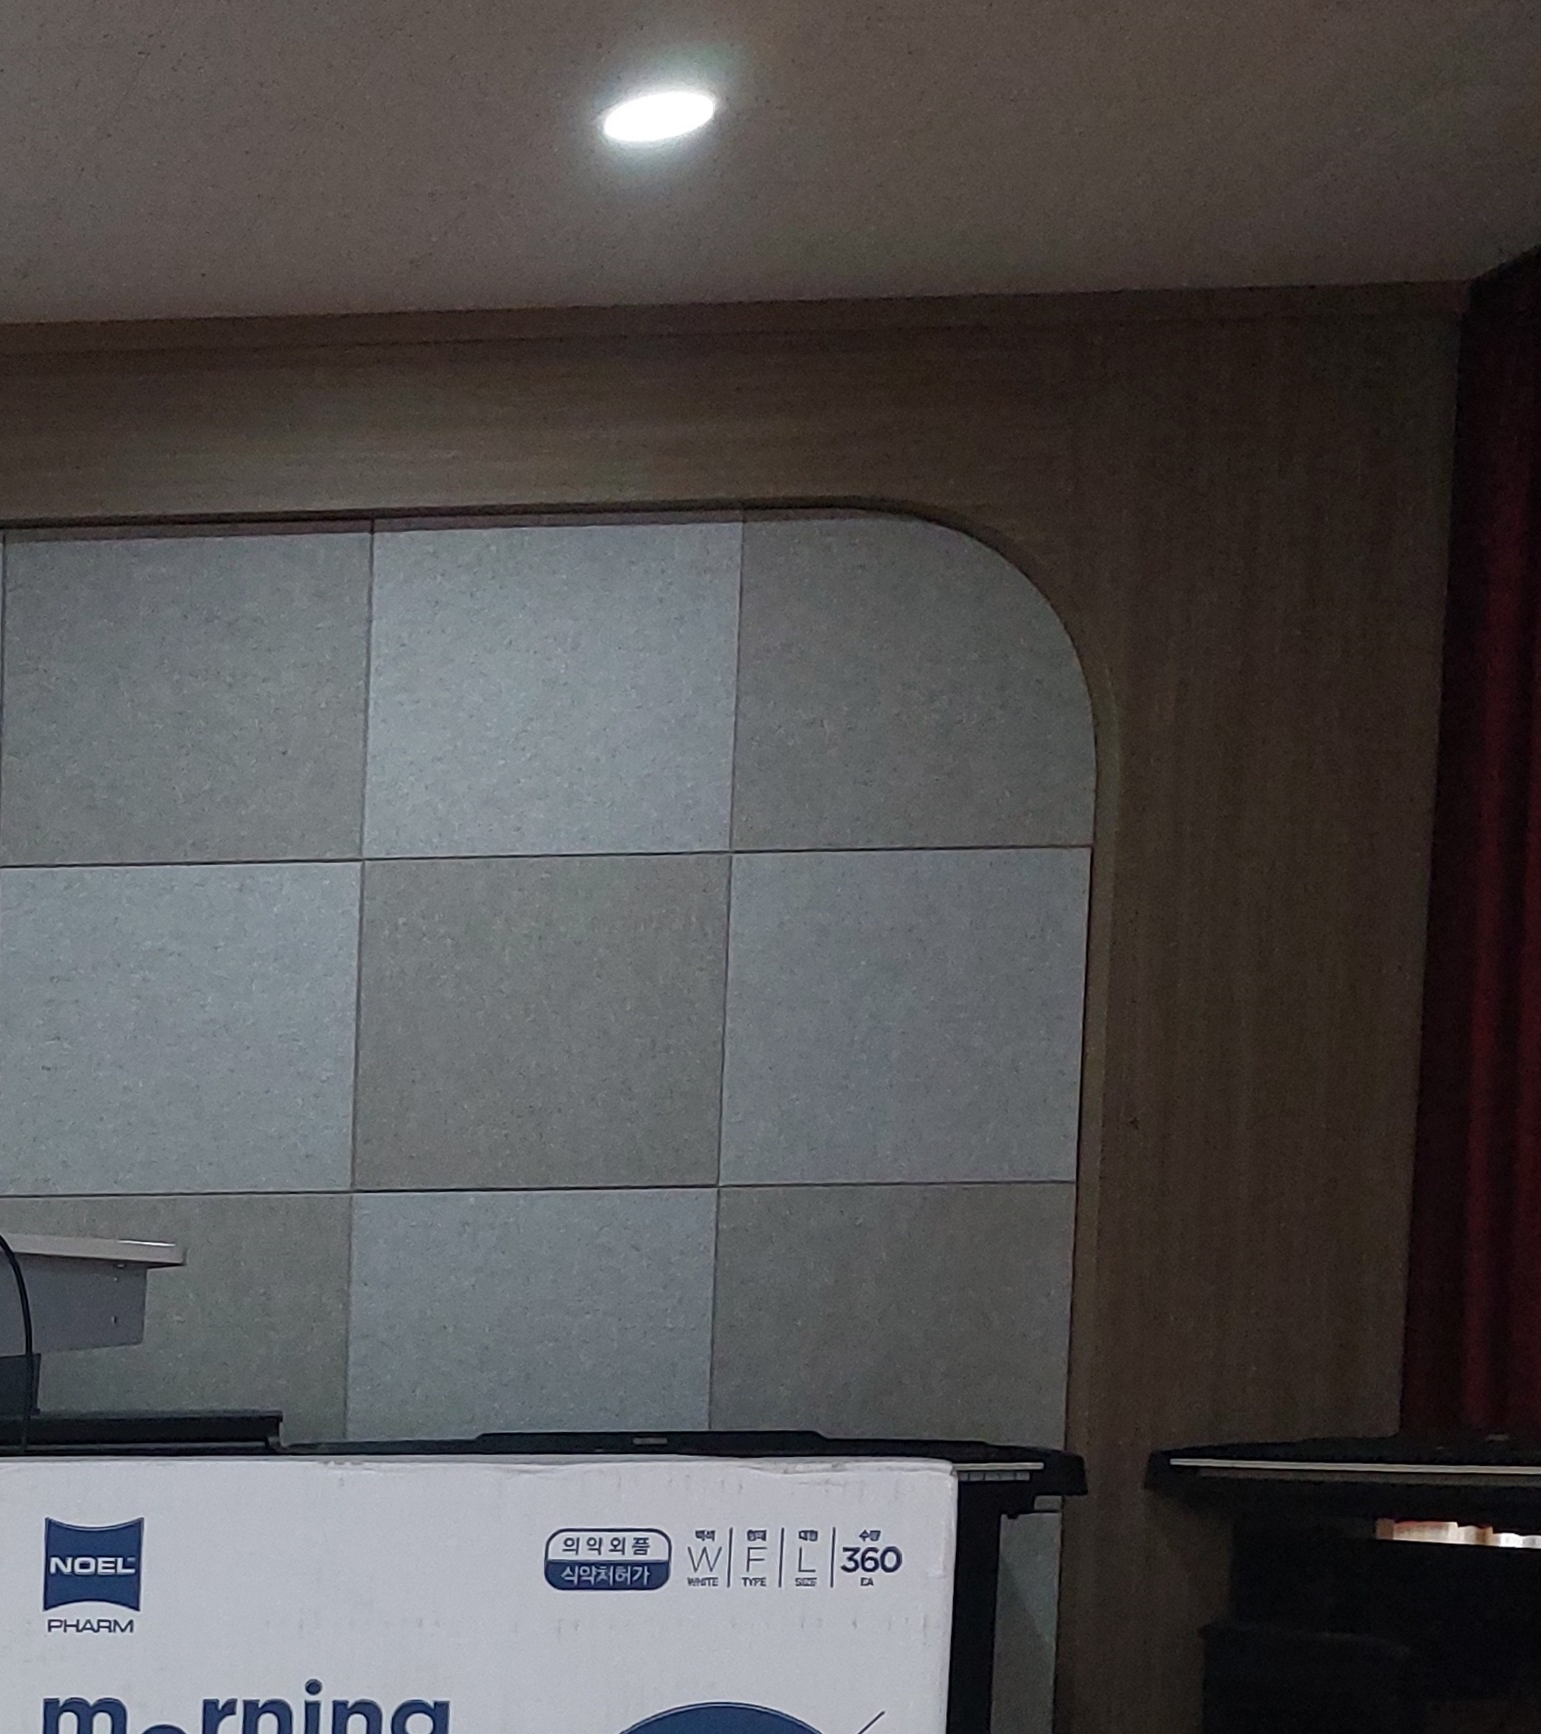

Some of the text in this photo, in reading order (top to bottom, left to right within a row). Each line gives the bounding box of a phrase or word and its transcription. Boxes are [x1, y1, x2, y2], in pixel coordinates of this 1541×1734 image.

[49, 1556, 136, 1575] NOEL
[686, 1545, 723, 1573] W
[746, 1546, 768, 1573] F
[797, 1546, 817, 1573] L
[840, 1546, 903, 1573] 360
[741, 1576, 767, 1587] TYPE
[47, 1619, 134, 1634] PHARM
